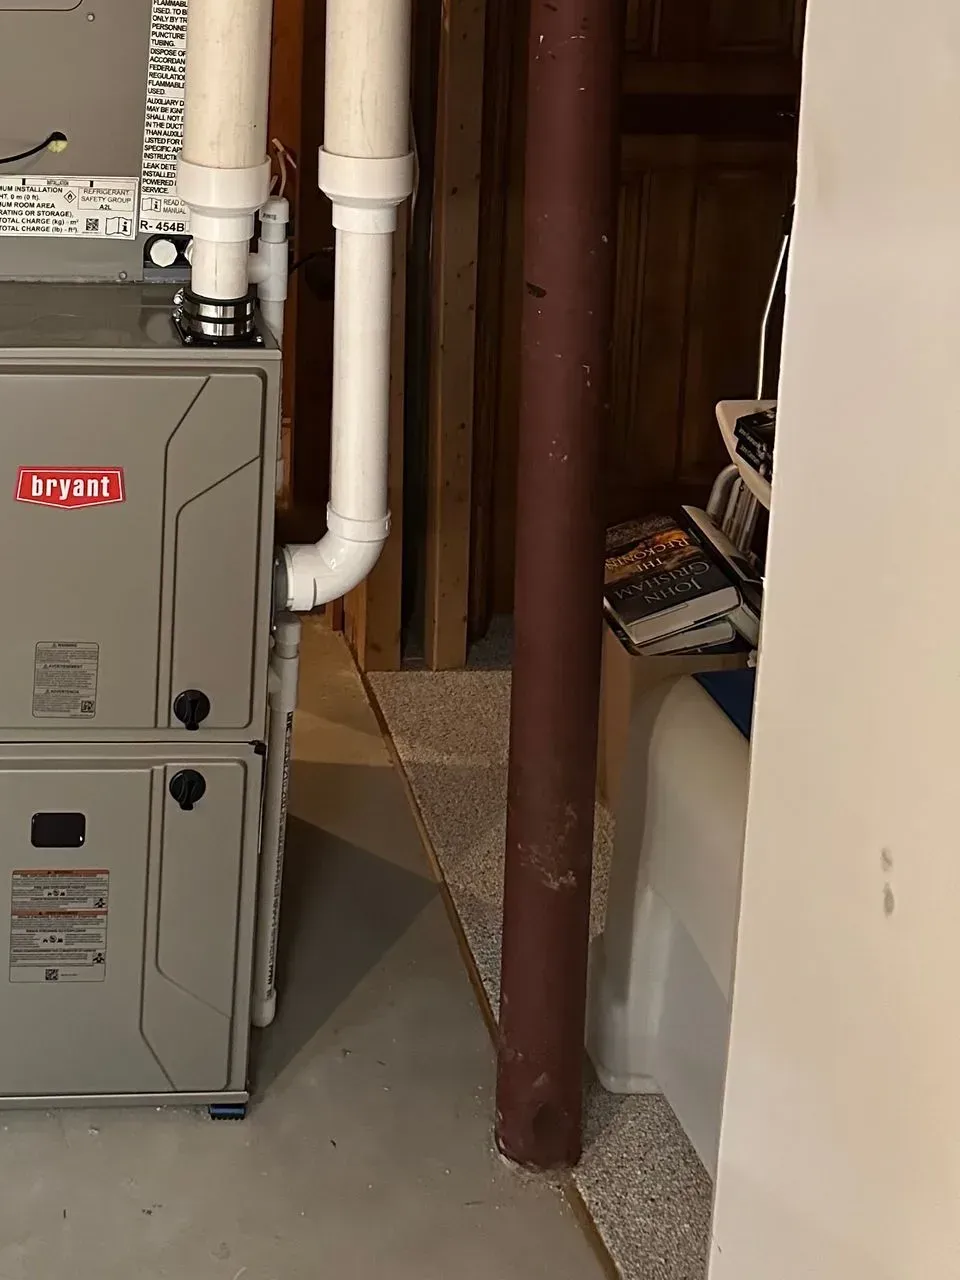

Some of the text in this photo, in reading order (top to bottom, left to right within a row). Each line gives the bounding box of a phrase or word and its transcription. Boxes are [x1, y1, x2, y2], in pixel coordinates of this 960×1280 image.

[152, 31, 185, 39] PUNCTURE
[151, 48, 177, 56] DISPOSE
[150, 64, 177, 72] FEDERAL
[141, 220, 184, 231] R- 454B
[32, 475, 109, 500] bryant
[614, 561, 710, 600] GRISHAM
[644, 578, 702, 604] JOHN
